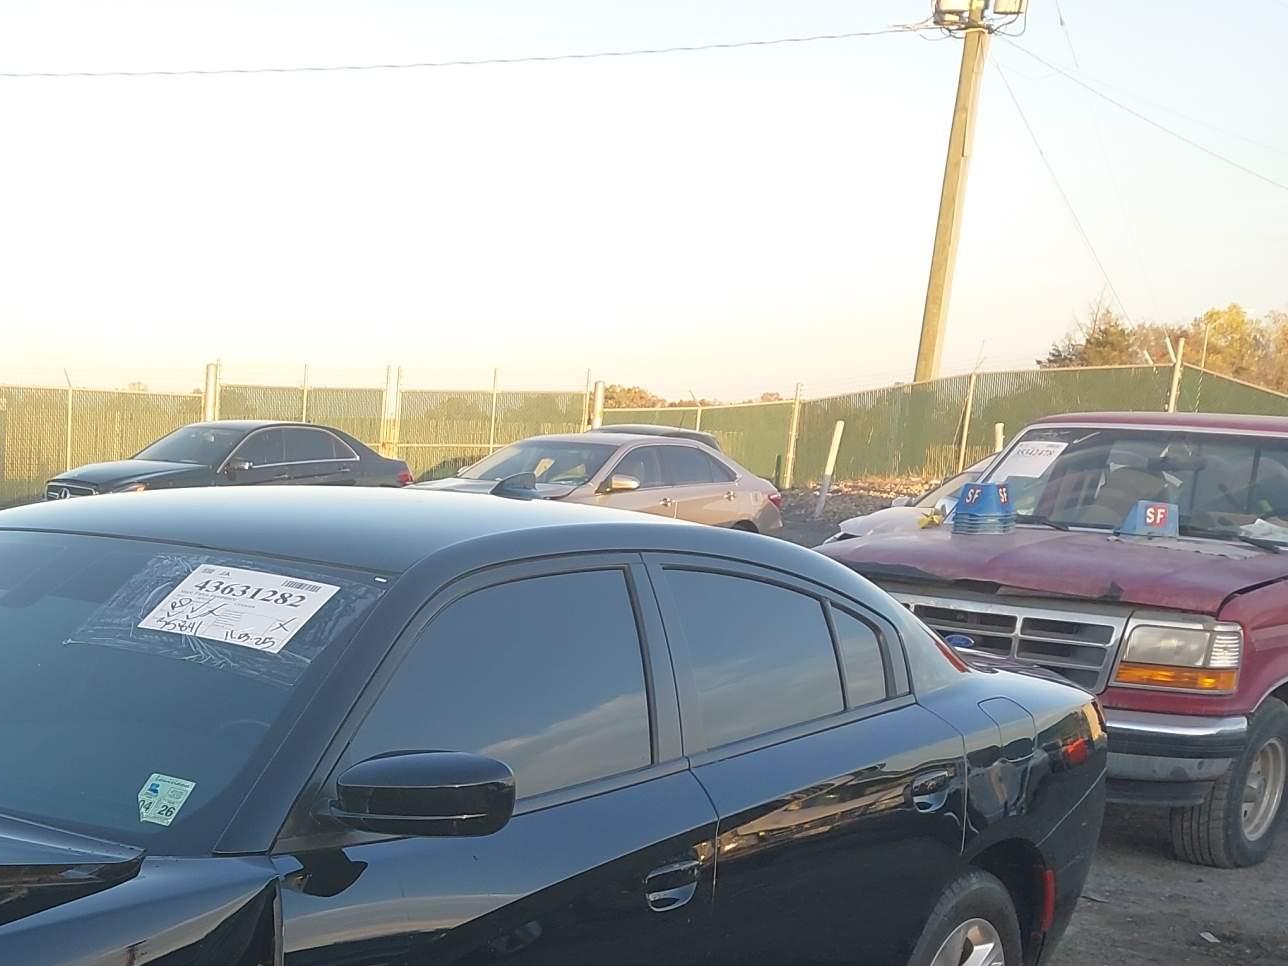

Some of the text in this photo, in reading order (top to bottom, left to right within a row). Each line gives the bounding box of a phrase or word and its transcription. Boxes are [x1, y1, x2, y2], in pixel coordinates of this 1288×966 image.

[966, 489, 982, 503] SF
[1146, 507, 1166, 523] SF
[194, 579, 307, 608] 43631282
[157, 804, 176, 817] 26
